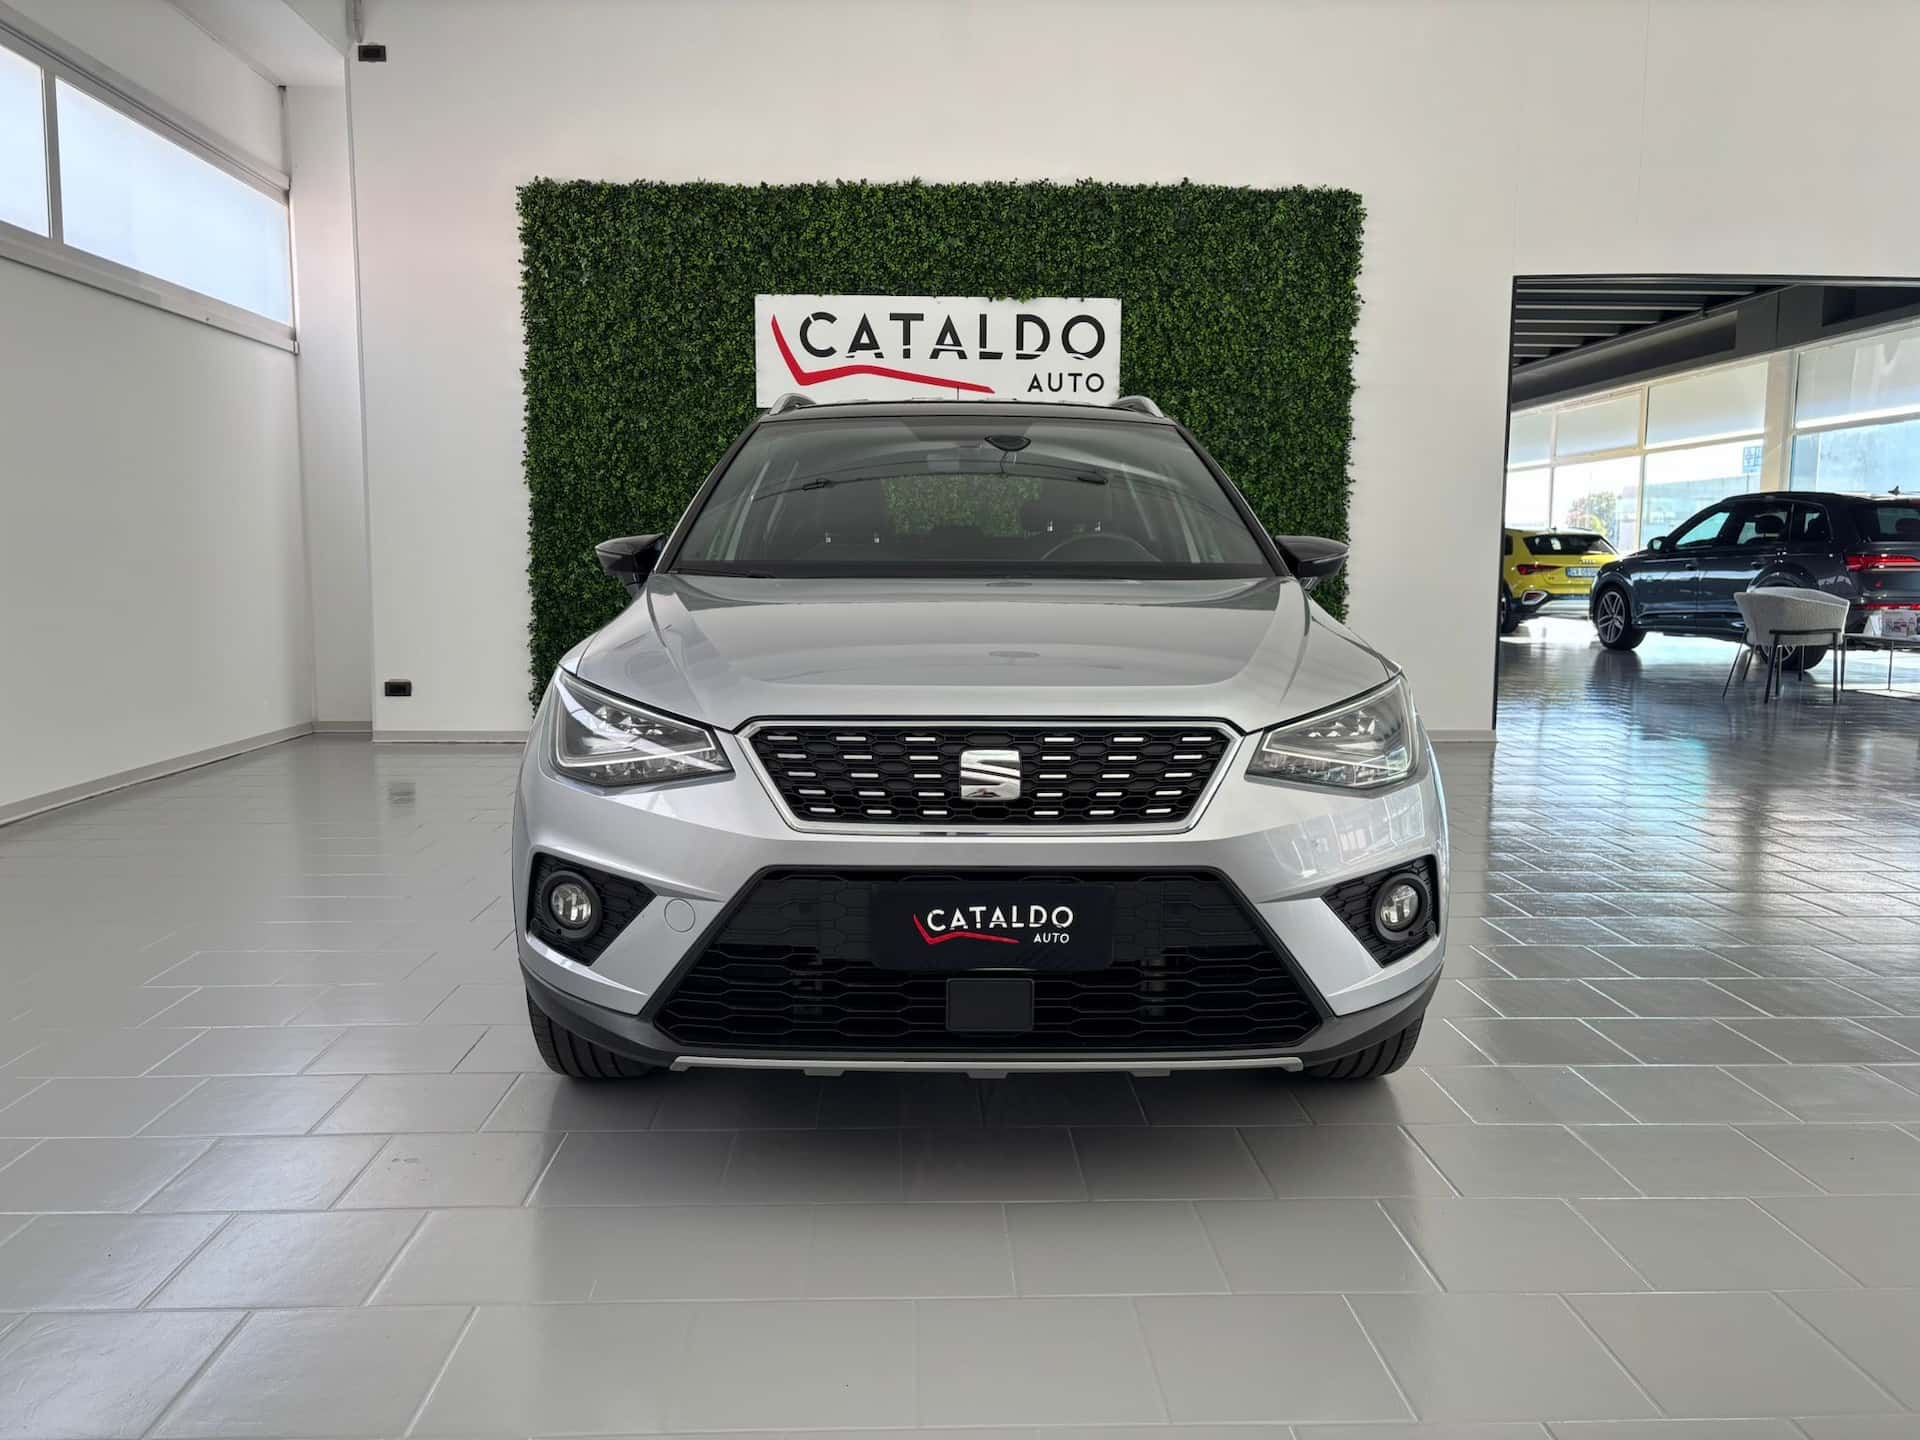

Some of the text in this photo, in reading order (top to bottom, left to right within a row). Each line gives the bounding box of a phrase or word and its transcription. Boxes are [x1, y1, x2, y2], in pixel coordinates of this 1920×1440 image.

[799, 311, 1106, 361] CATALDO
[1027, 372, 1105, 393] AUTO
[926, 904, 1074, 931] CATALDO
[1033, 932, 1070, 944] AUTO
